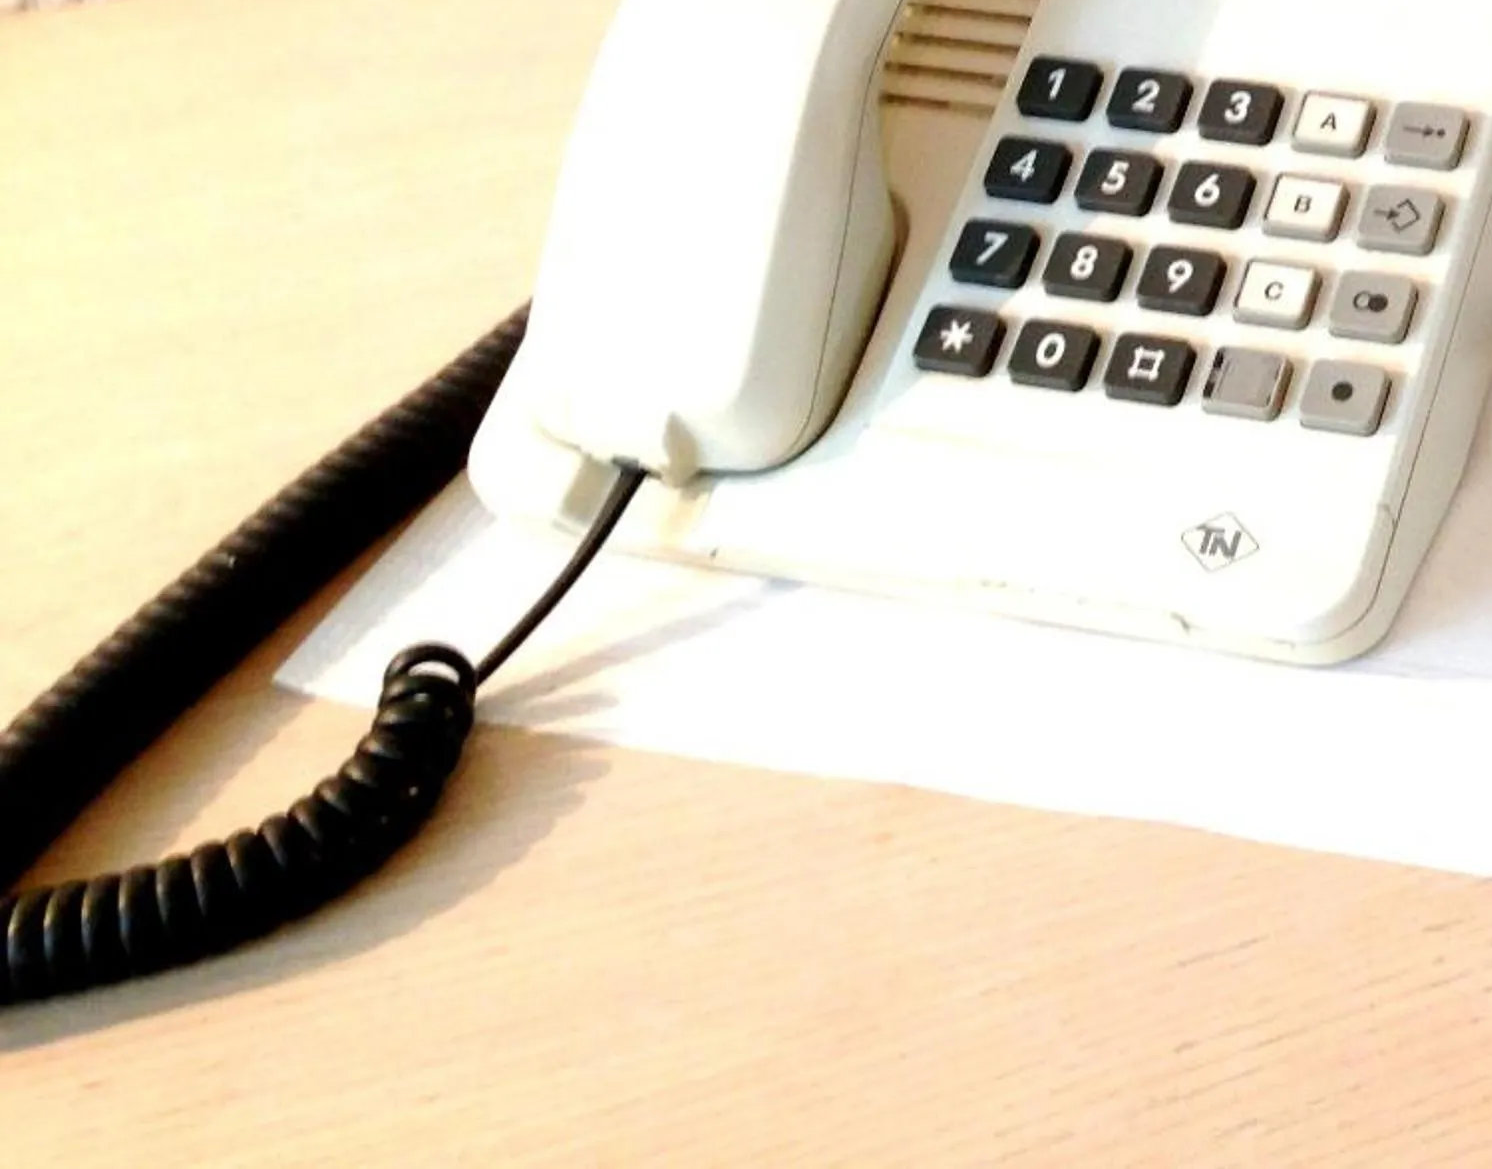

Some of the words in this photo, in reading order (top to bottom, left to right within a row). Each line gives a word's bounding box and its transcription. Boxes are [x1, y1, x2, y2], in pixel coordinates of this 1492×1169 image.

[1048, 68, 1066, 100] 1
[1132, 79, 1161, 113] 2
[1224, 90, 1253, 124] 3
[1320, 112, 1338, 131] A
[1009, 149, 1038, 181] 4
[1100, 160, 1131, 195] 5
[1193, 173, 1221, 207] 6
[1293, 195, 1311, 213] B
[976, 232, 1009, 264] 7
[1069, 245, 1098, 280] 8
[1165, 258, 1194, 294] 9
[1263, 281, 1284, 301] C
[1034, 331, 1067, 369] 0
[1196, 523, 1242, 560] TN
